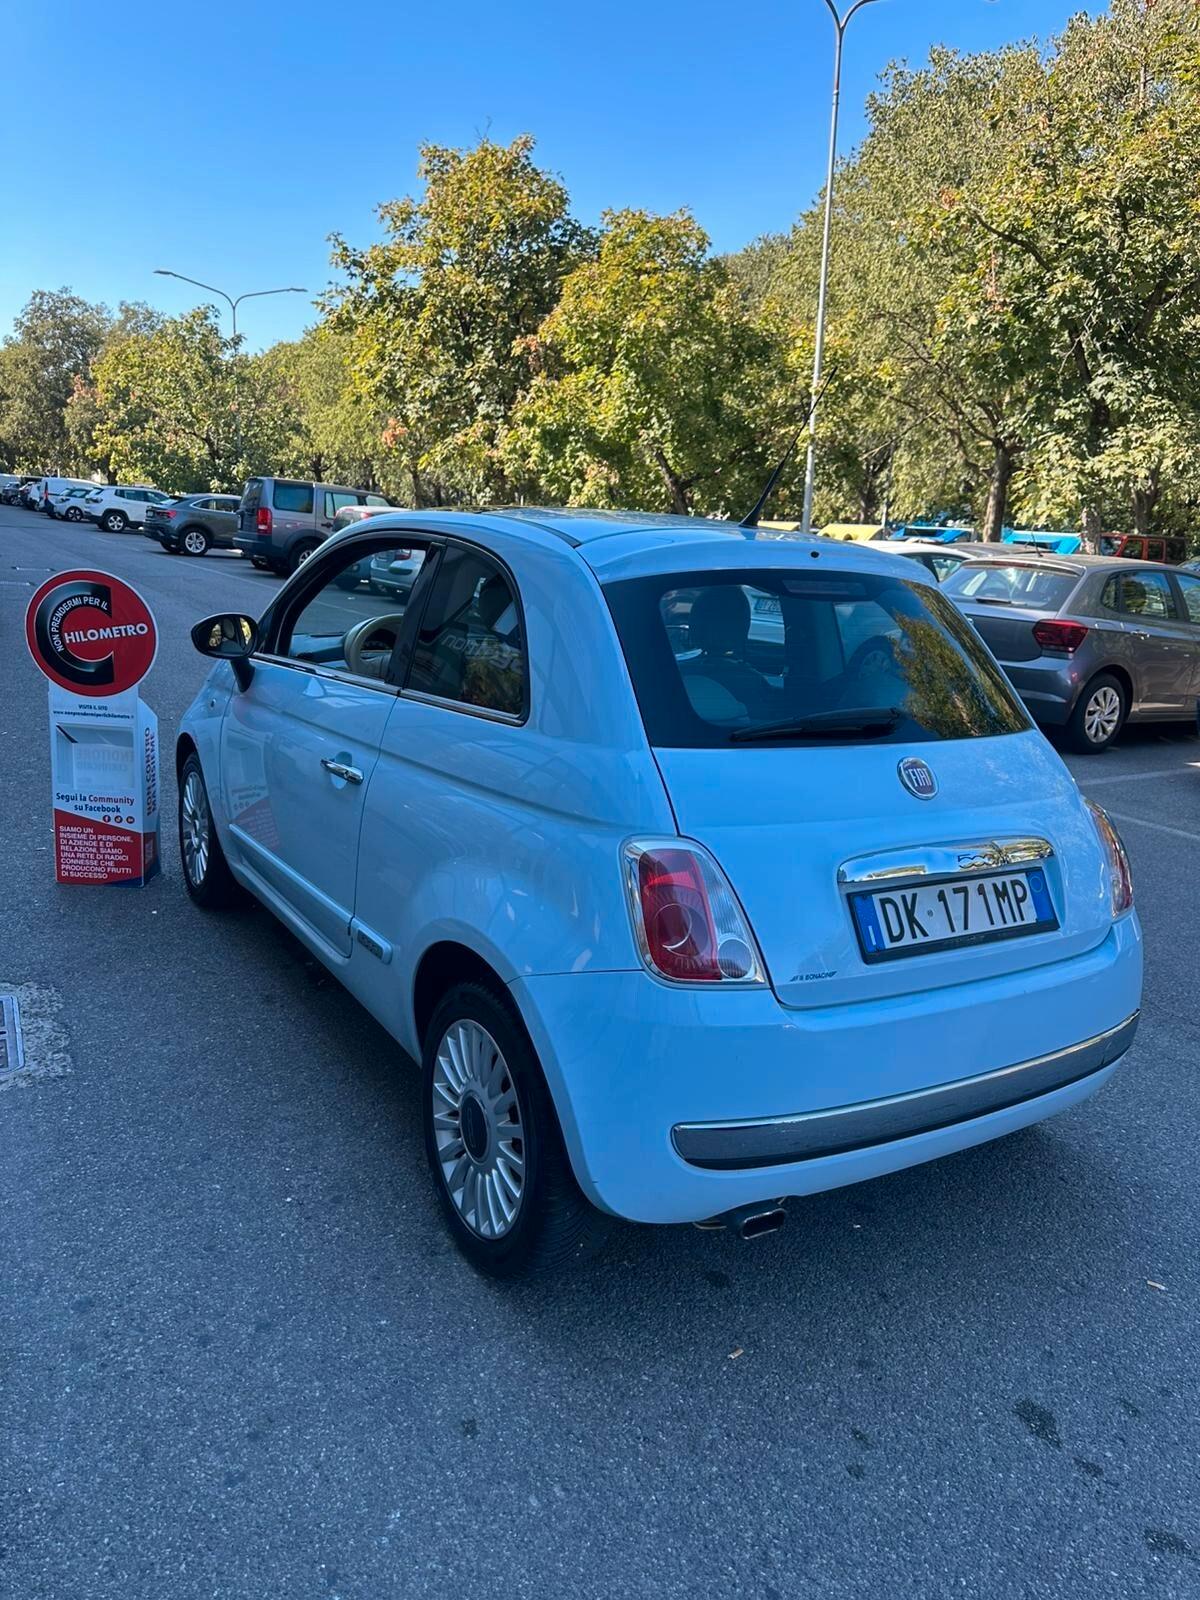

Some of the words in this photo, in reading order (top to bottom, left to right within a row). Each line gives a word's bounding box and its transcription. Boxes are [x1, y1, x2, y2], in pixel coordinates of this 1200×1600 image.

[83, 596, 100, 606] PER
[101, 600, 108, 611] IL
[51, 597, 82, 632] PRENDERMI
[53, 634, 64, 652] NON
[908, 767, 932, 787] FIAT
[56, 792, 78, 802] Segui
[79, 793, 87, 801] la
[88, 794, 135, 806] Community
[84, 804, 121, 813] Facebook
[61, 858, 98, 866] CONNESSE
[61, 864, 105, 872] PRODUCONO
[70, 871, 108, 879] SUCCESSO
[879, 893, 929, 943] DK
